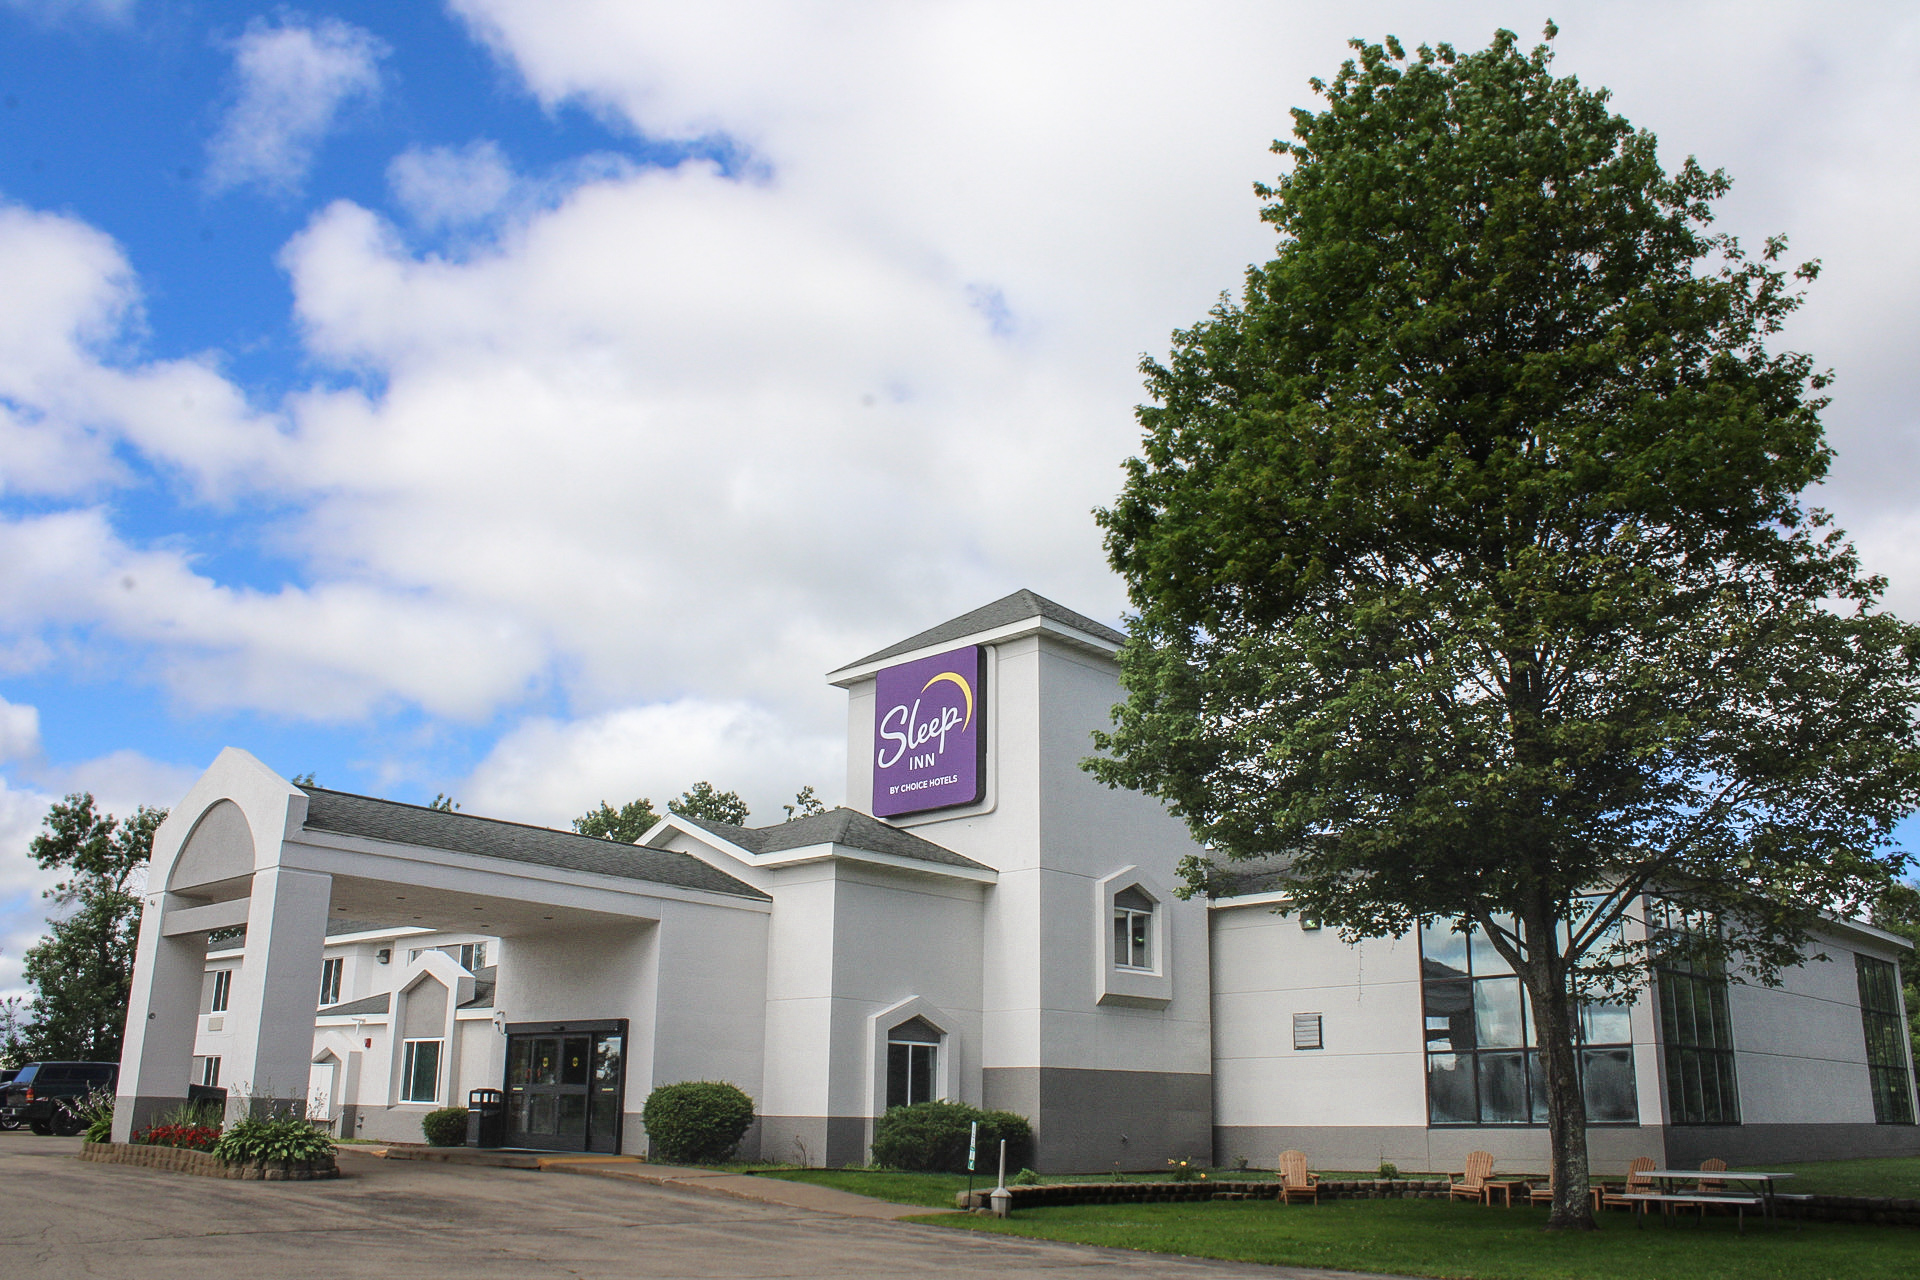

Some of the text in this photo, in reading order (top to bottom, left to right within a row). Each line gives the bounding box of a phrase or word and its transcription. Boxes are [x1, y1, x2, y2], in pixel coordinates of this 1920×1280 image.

[878, 698, 963, 769] Sleep
[909, 752, 935, 770] INN
[889, 774, 958, 795] BY CHOICE HOTELS
